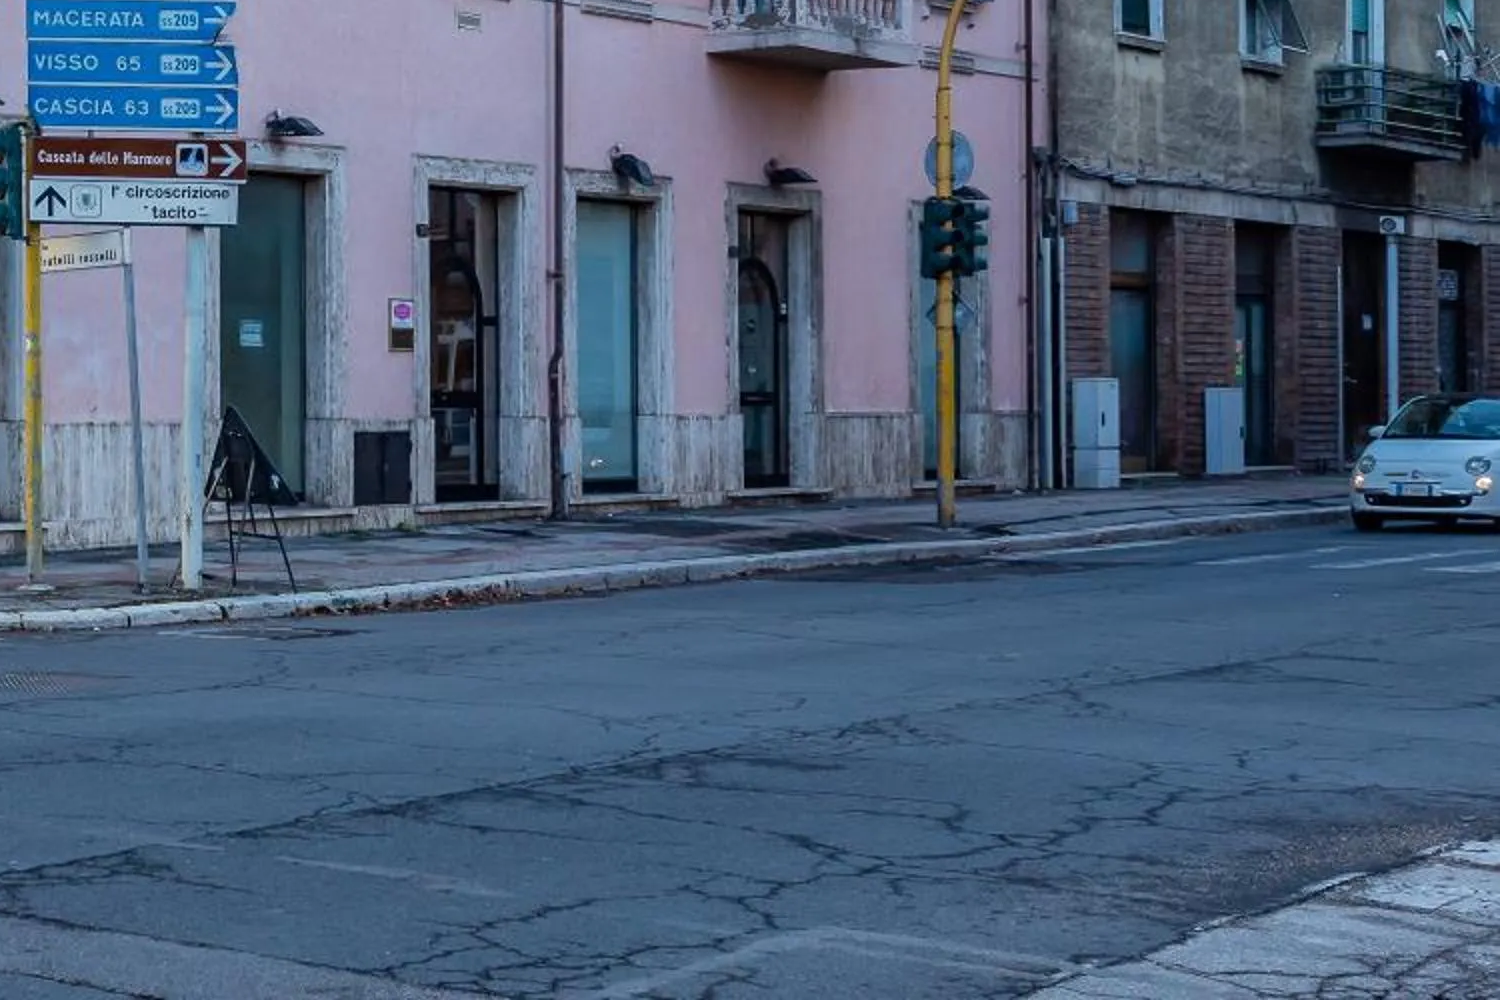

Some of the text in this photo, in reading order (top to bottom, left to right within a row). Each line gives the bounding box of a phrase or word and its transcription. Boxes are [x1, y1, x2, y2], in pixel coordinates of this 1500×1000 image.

[33, 10, 144, 27] MACERATA
[35, 54, 98, 71] VISSO
[116, 55, 141, 71] 65
[35, 98, 114, 115] CASCIA
[124, 99, 149, 116] 63
[37, 149, 173, 166] Cascata delle Marmore
[125, 185, 230, 200] circoscrizione
[41, 249, 117, 267] ratelli rosselli
